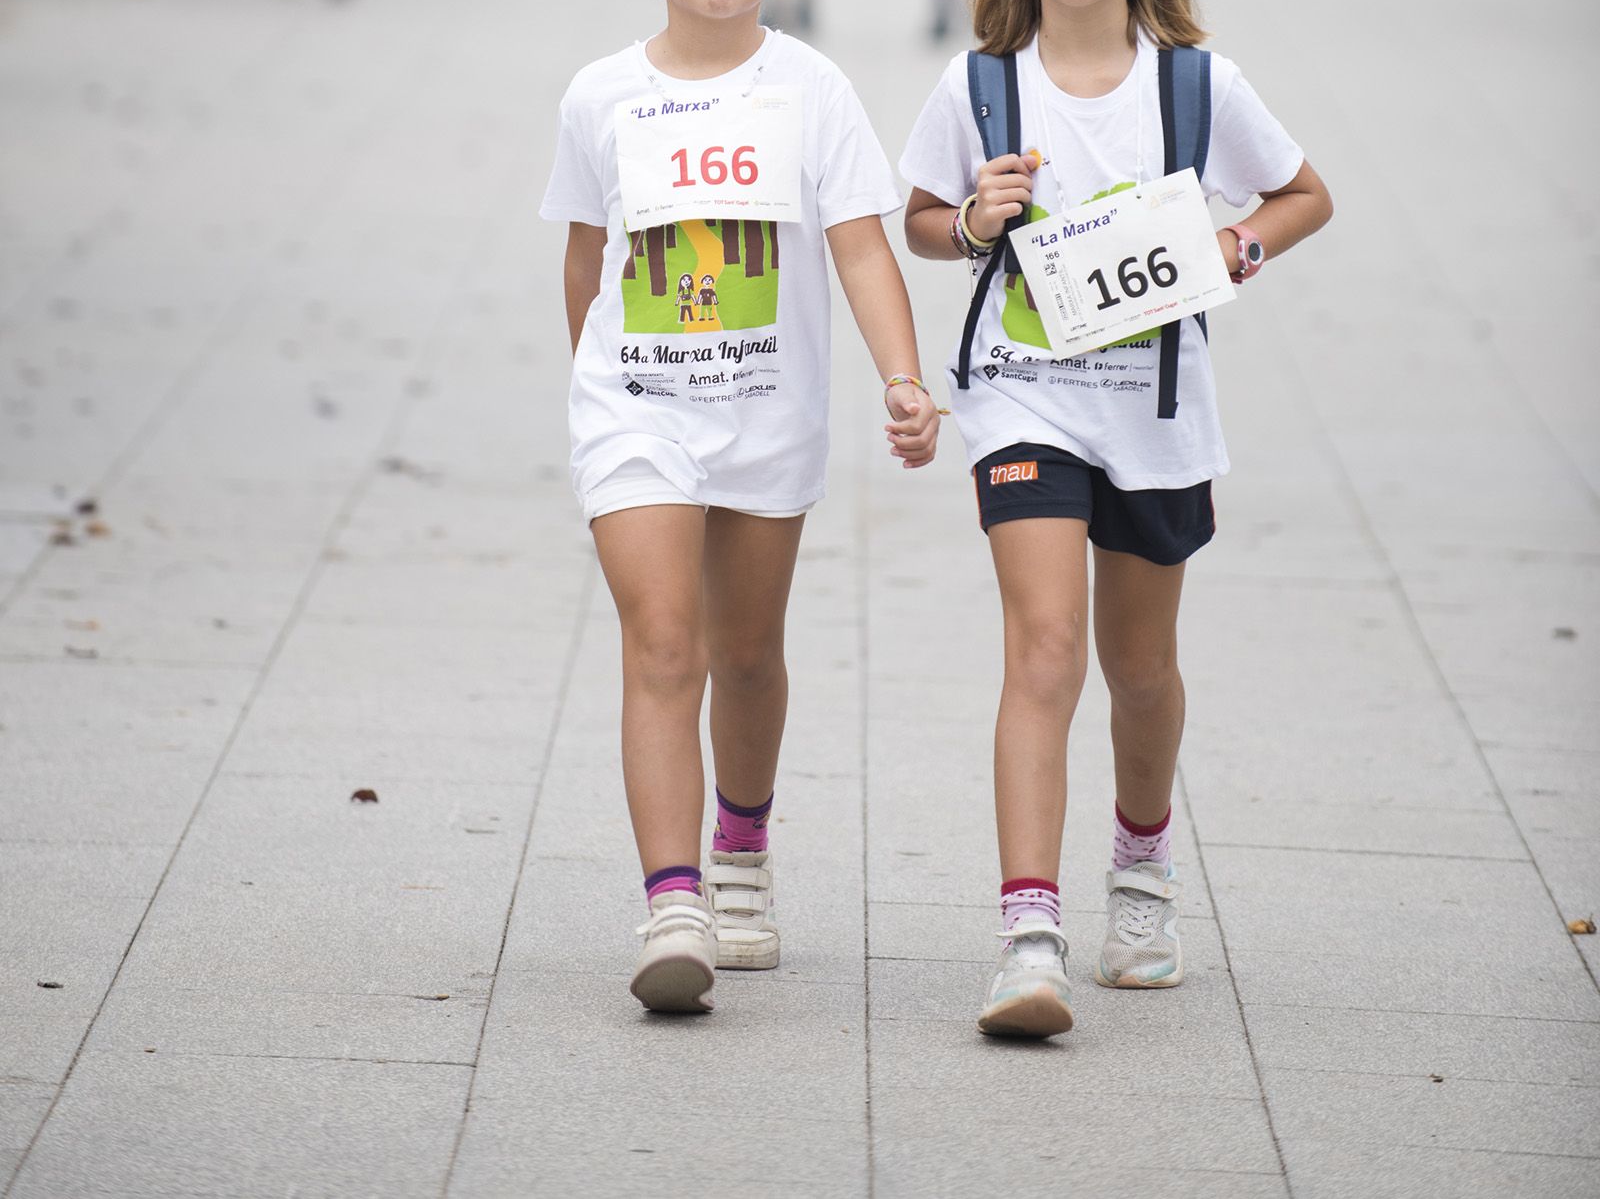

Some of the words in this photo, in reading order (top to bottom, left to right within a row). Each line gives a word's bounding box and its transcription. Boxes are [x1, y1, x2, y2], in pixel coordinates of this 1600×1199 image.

[671, 145, 758, 188] 166
[1045, 250, 1060, 261] 166
[1087, 246, 1178, 311] 166
[653, 344, 714, 364] Marxa
[718, 335, 778, 364] Infantil
[1104, 361, 1128, 371] ferrer
[745, 383, 777, 394] LEXUS
[1057, 377, 1098, 389] FERTRES
[1114, 379, 1151, 388] LEXUS
